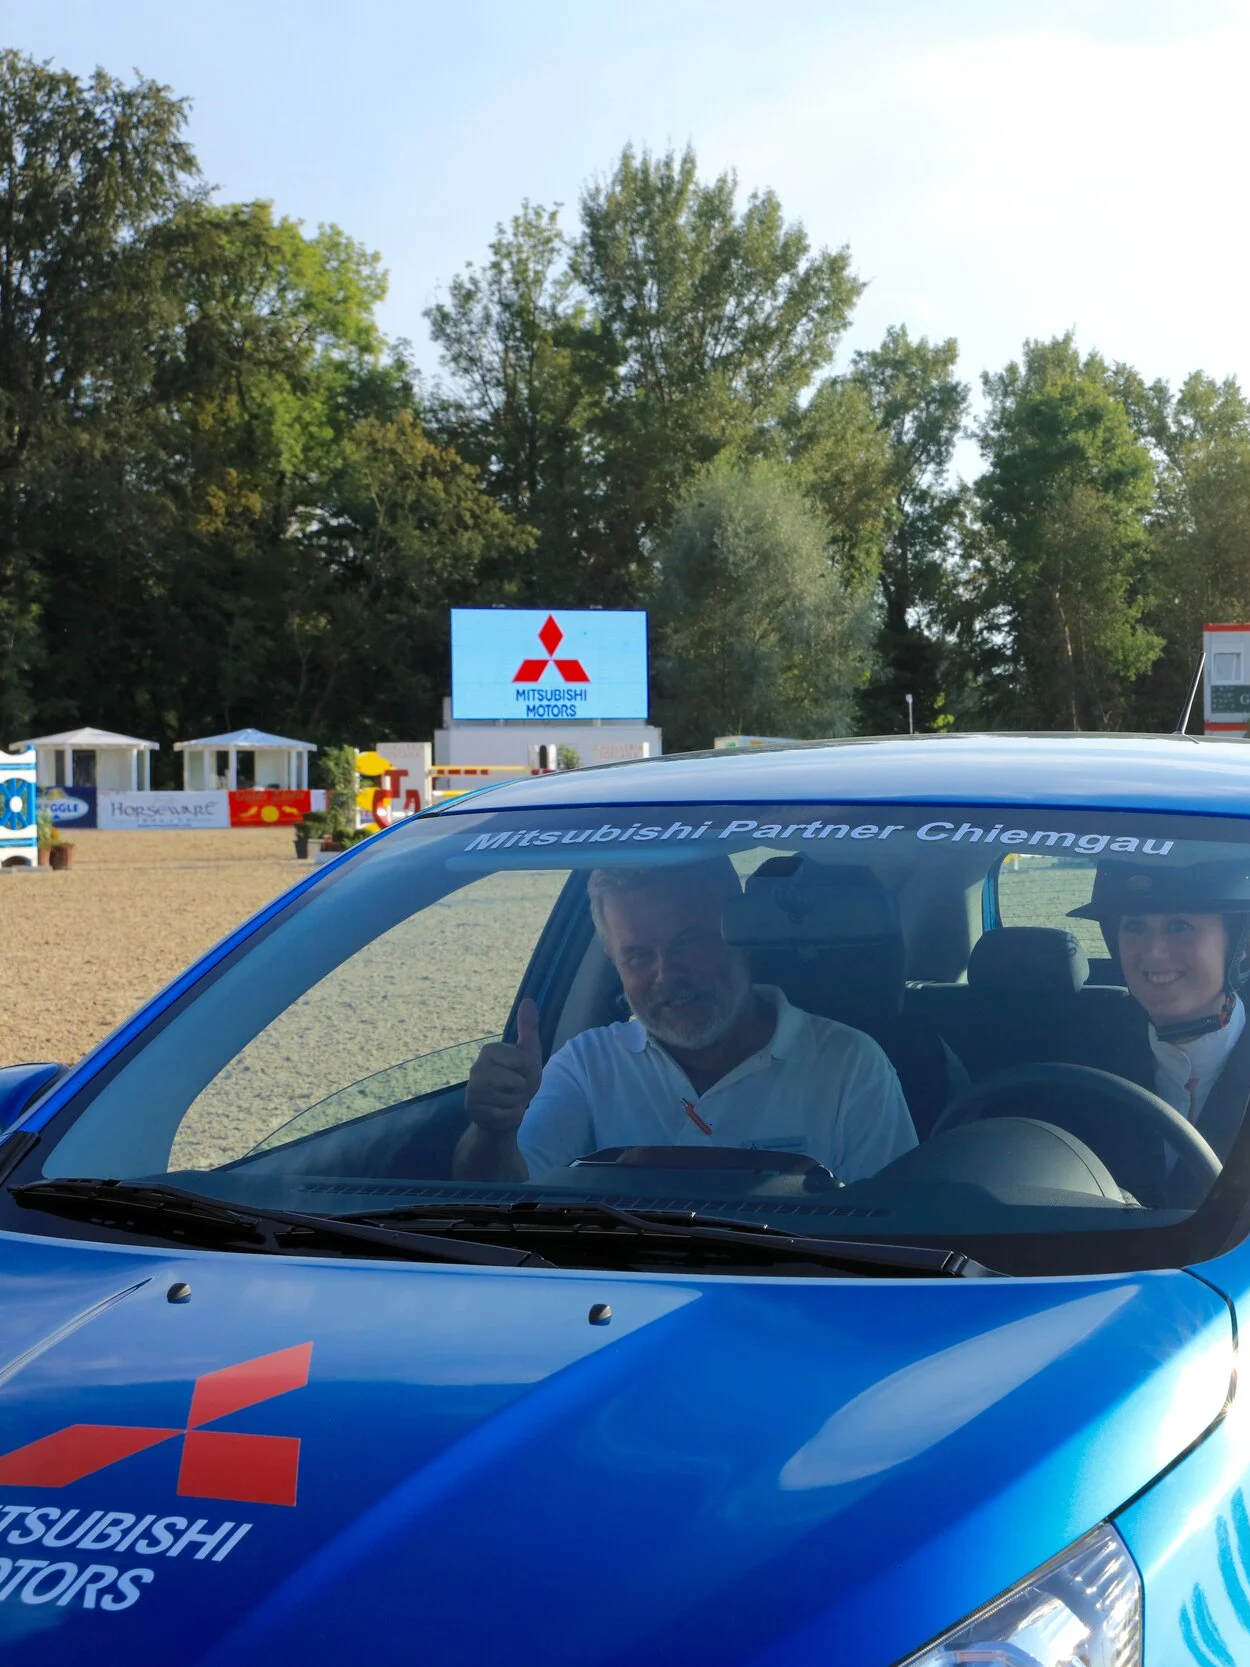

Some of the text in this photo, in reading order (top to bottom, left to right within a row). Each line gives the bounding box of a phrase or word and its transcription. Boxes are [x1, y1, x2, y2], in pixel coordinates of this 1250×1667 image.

[515, 689, 587, 702] MITSUBISHI
[526, 704, 577, 718] MOTORS
[464, 820, 1175, 855] Mitsubishi Partner Chiemgau
[0, 1504, 253, 1562] TSUBISHI
